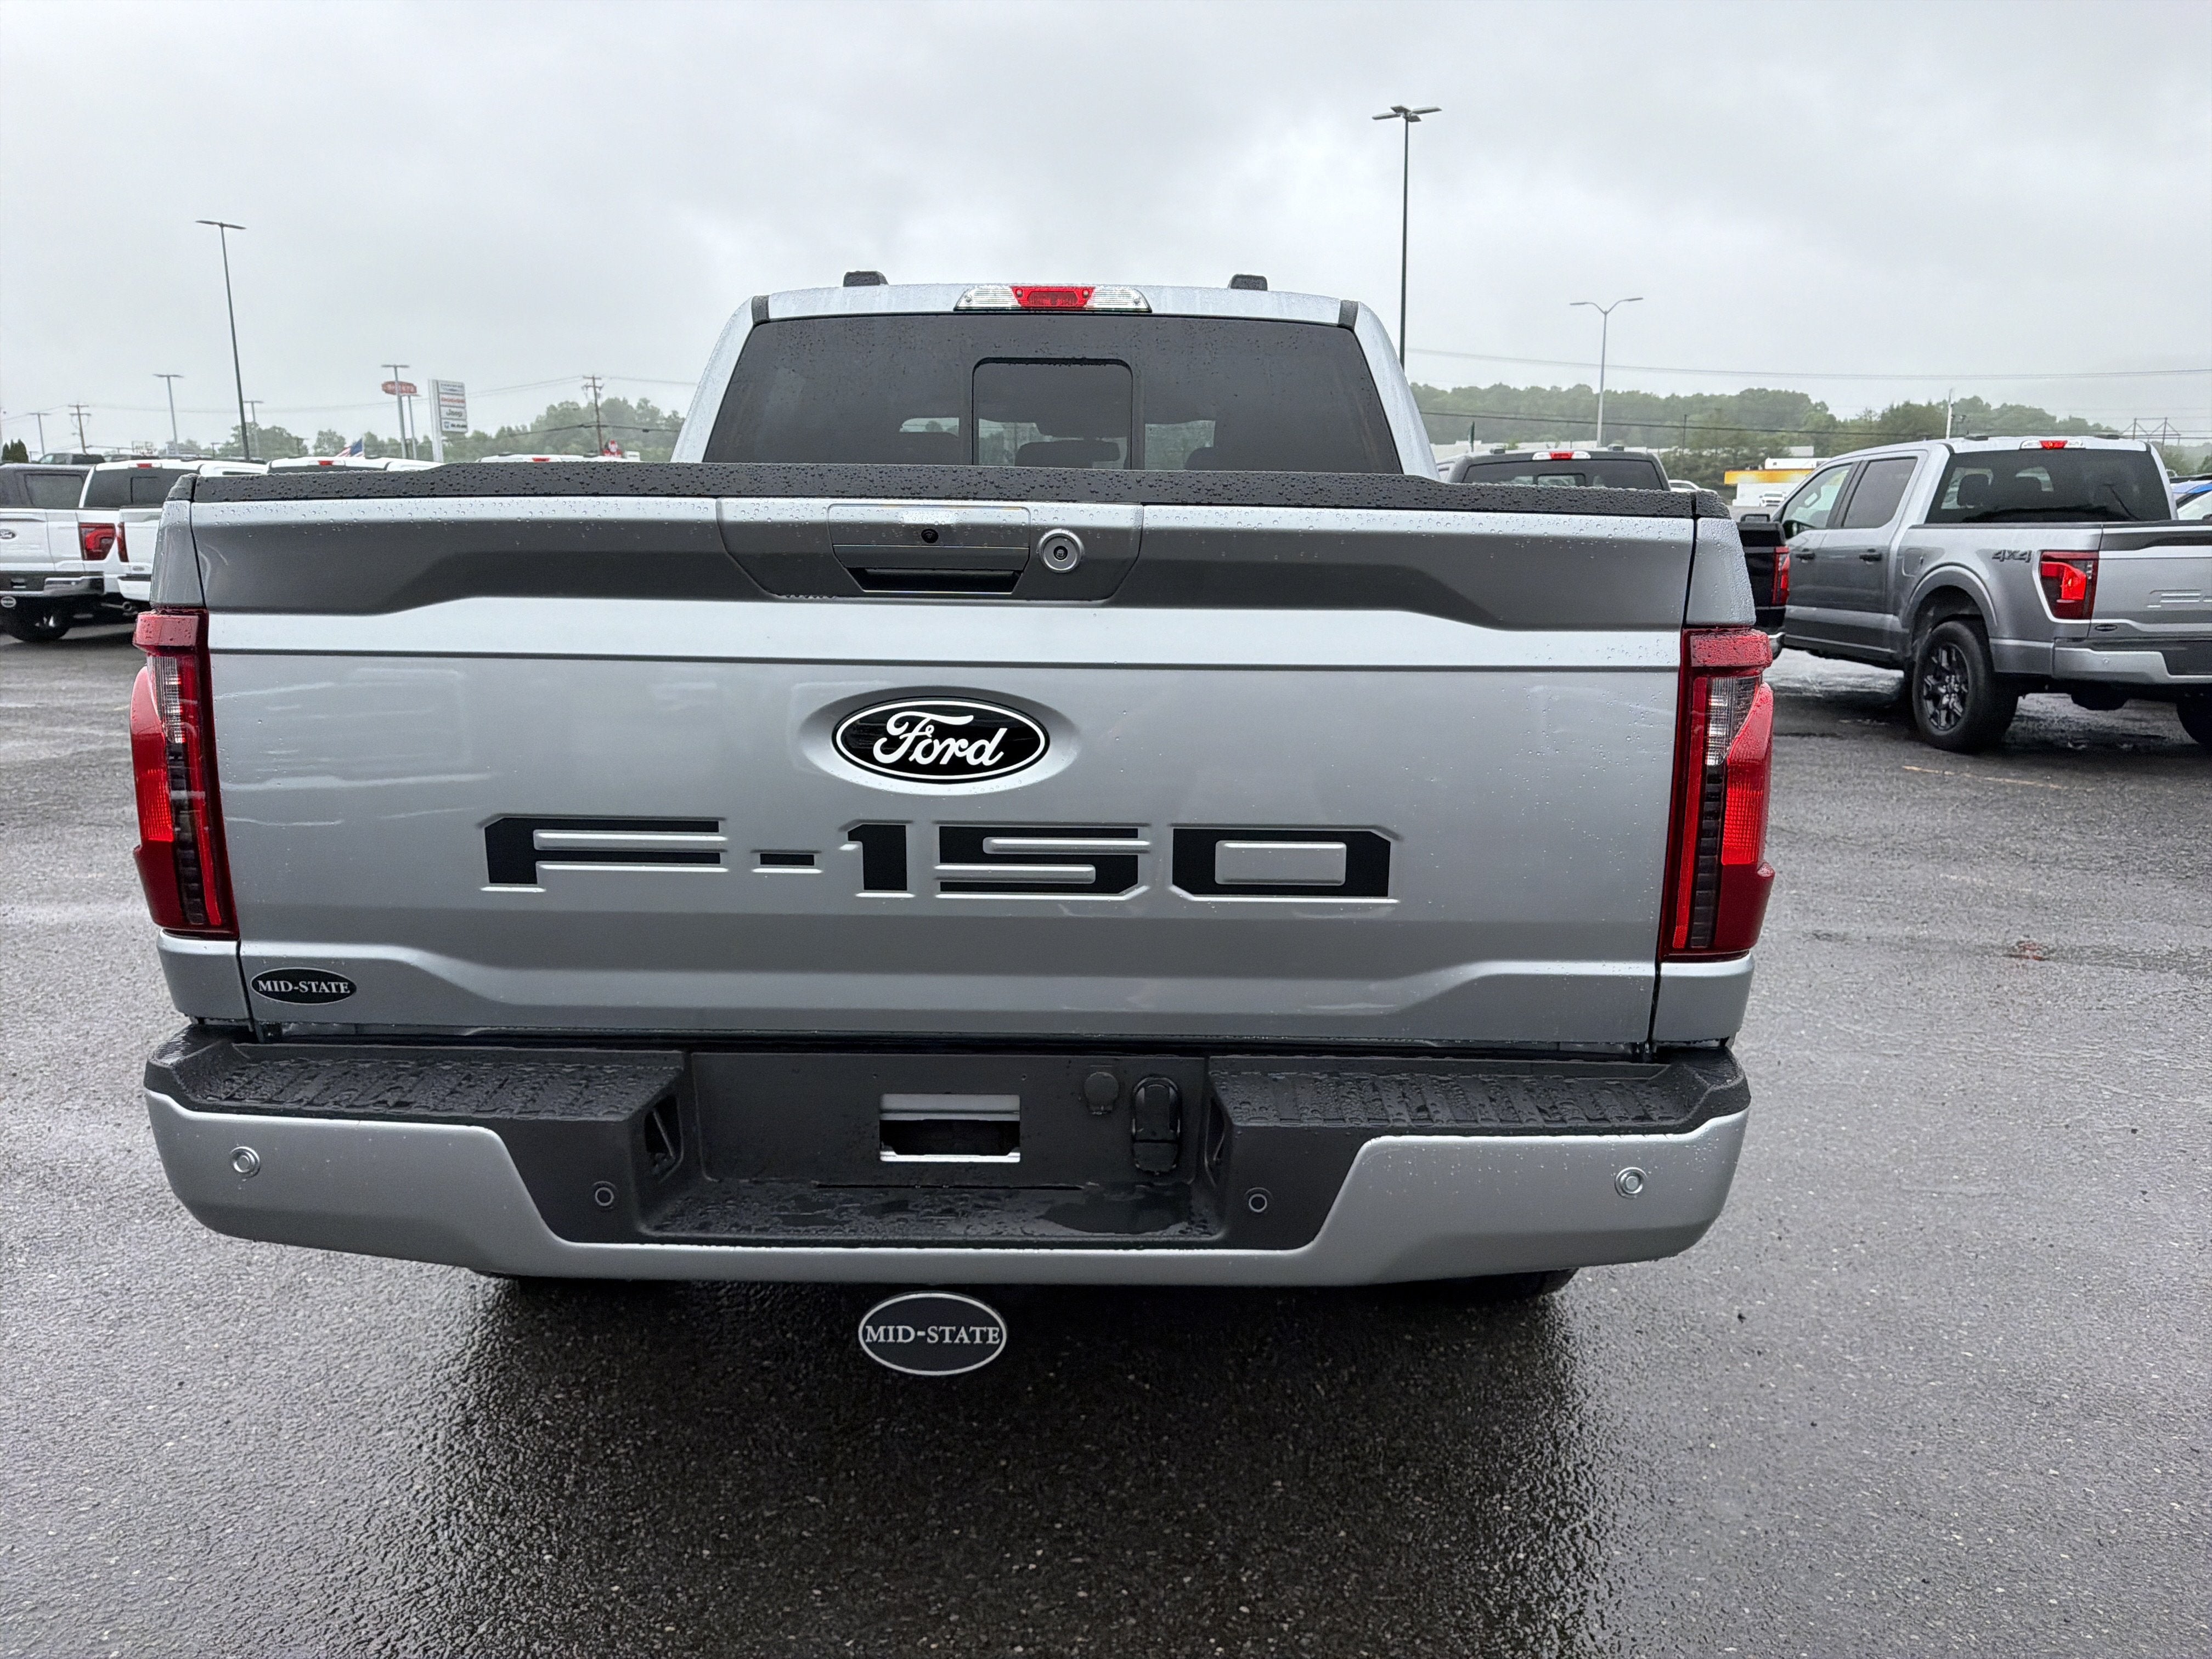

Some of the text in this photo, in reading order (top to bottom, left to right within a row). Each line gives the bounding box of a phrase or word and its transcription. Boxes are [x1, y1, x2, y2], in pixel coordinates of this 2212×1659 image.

[446, 409, 462, 417] Jeep
[873, 711, 1007, 765] Ford
[482, 814, 1396, 902] F-150
[257, 980, 351, 994] MID-STATE
[865, 1325, 1000, 1344] MID-STATE
